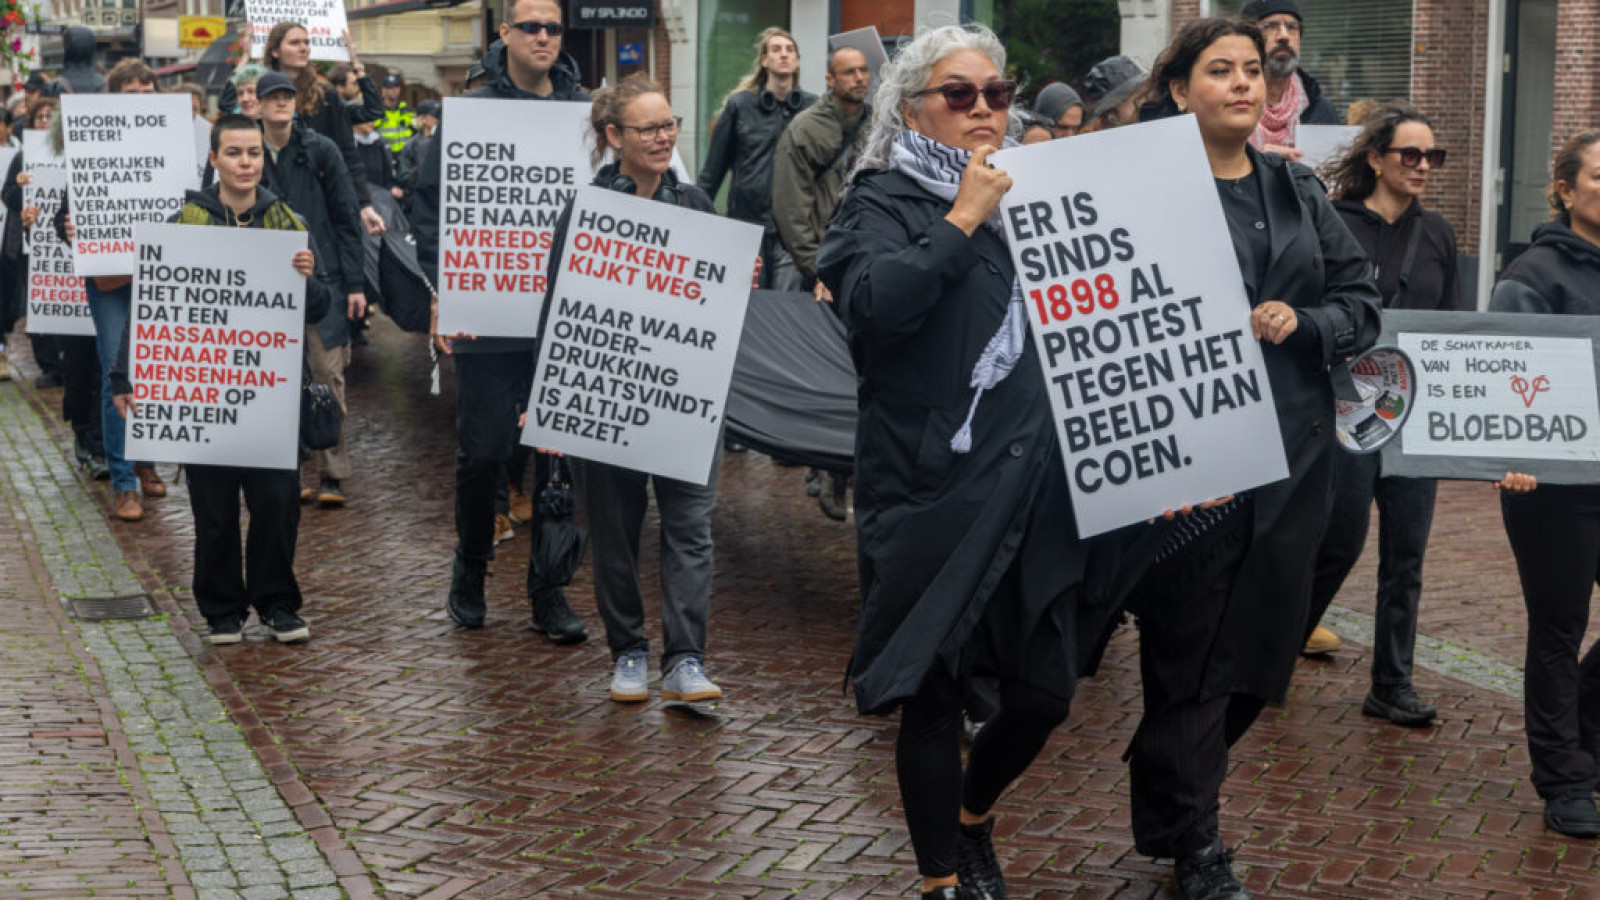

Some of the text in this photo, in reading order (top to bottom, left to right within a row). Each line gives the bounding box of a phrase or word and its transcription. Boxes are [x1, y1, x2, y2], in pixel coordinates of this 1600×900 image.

[68, 115, 166, 128] HOORN, DOE
[69, 130, 121, 142] BETER!
[447, 142, 514, 161] COEN
[72, 157, 164, 169] WEGKIJKEN
[72, 172, 88, 183] IN
[92, 170, 152, 183] PLAATS
[447, 164, 574, 184] BEZORGDE
[73, 186, 108, 198] VAN
[446, 186, 577, 206] NEDERLAN
[446, 206, 475, 225] DE
[1008, 192, 1097, 241] ER IS
[34, 231, 62, 244] GE
[77, 227, 131, 239] NEMEN
[578, 210, 670, 247] HOORN
[33, 245, 64, 258] STA
[140, 244, 162, 261] IN
[444, 250, 549, 270] NATIEST
[574, 233, 726, 283] ONTKENT EN
[1020, 228, 1134, 282] SINDS
[32, 261, 50, 272] JE
[139, 264, 245, 286] HOORN IS
[444, 272, 486, 291] TER
[568, 254, 706, 305] KIJKT WEG,
[139, 284, 297, 310] HET NORMAAL
[1030, 264, 1174, 325] 1898 AL
[138, 304, 228, 325] DAT EEN
[558, 298, 716, 352] MAAR WAAR
[137, 324, 298, 348] MASSAMOOR-
[554, 320, 650, 355] ONDER-
[1042, 296, 1205, 367] PROTEST
[136, 344, 260, 366] DENAAR EN
[1422, 340, 1533, 350] DE SCHATKAMER
[548, 342, 678, 386] DRUKKING
[1052, 330, 1242, 409] TEGEN HET
[1421, 358, 1526, 374] VAN HOORN
[136, 364, 286, 387] MENSENHAN-
[134, 384, 256, 405] DELAAR OP
[543, 364, 719, 423] PLAATSVINDT,
[1428, 384, 1445, 397] IS
[1453, 385, 1486, 398] EEN
[133, 404, 237, 425] EEN PLEIN
[538, 386, 650, 426] IS ALTIJD
[1064, 369, 1262, 453] BEELD VAN
[132, 423, 210, 442] STAAT.
[535, 408, 629, 446] VERZET.
[1428, 411, 1587, 442] BLOEDBAD
[1075, 434, 1192, 494] COEN.
